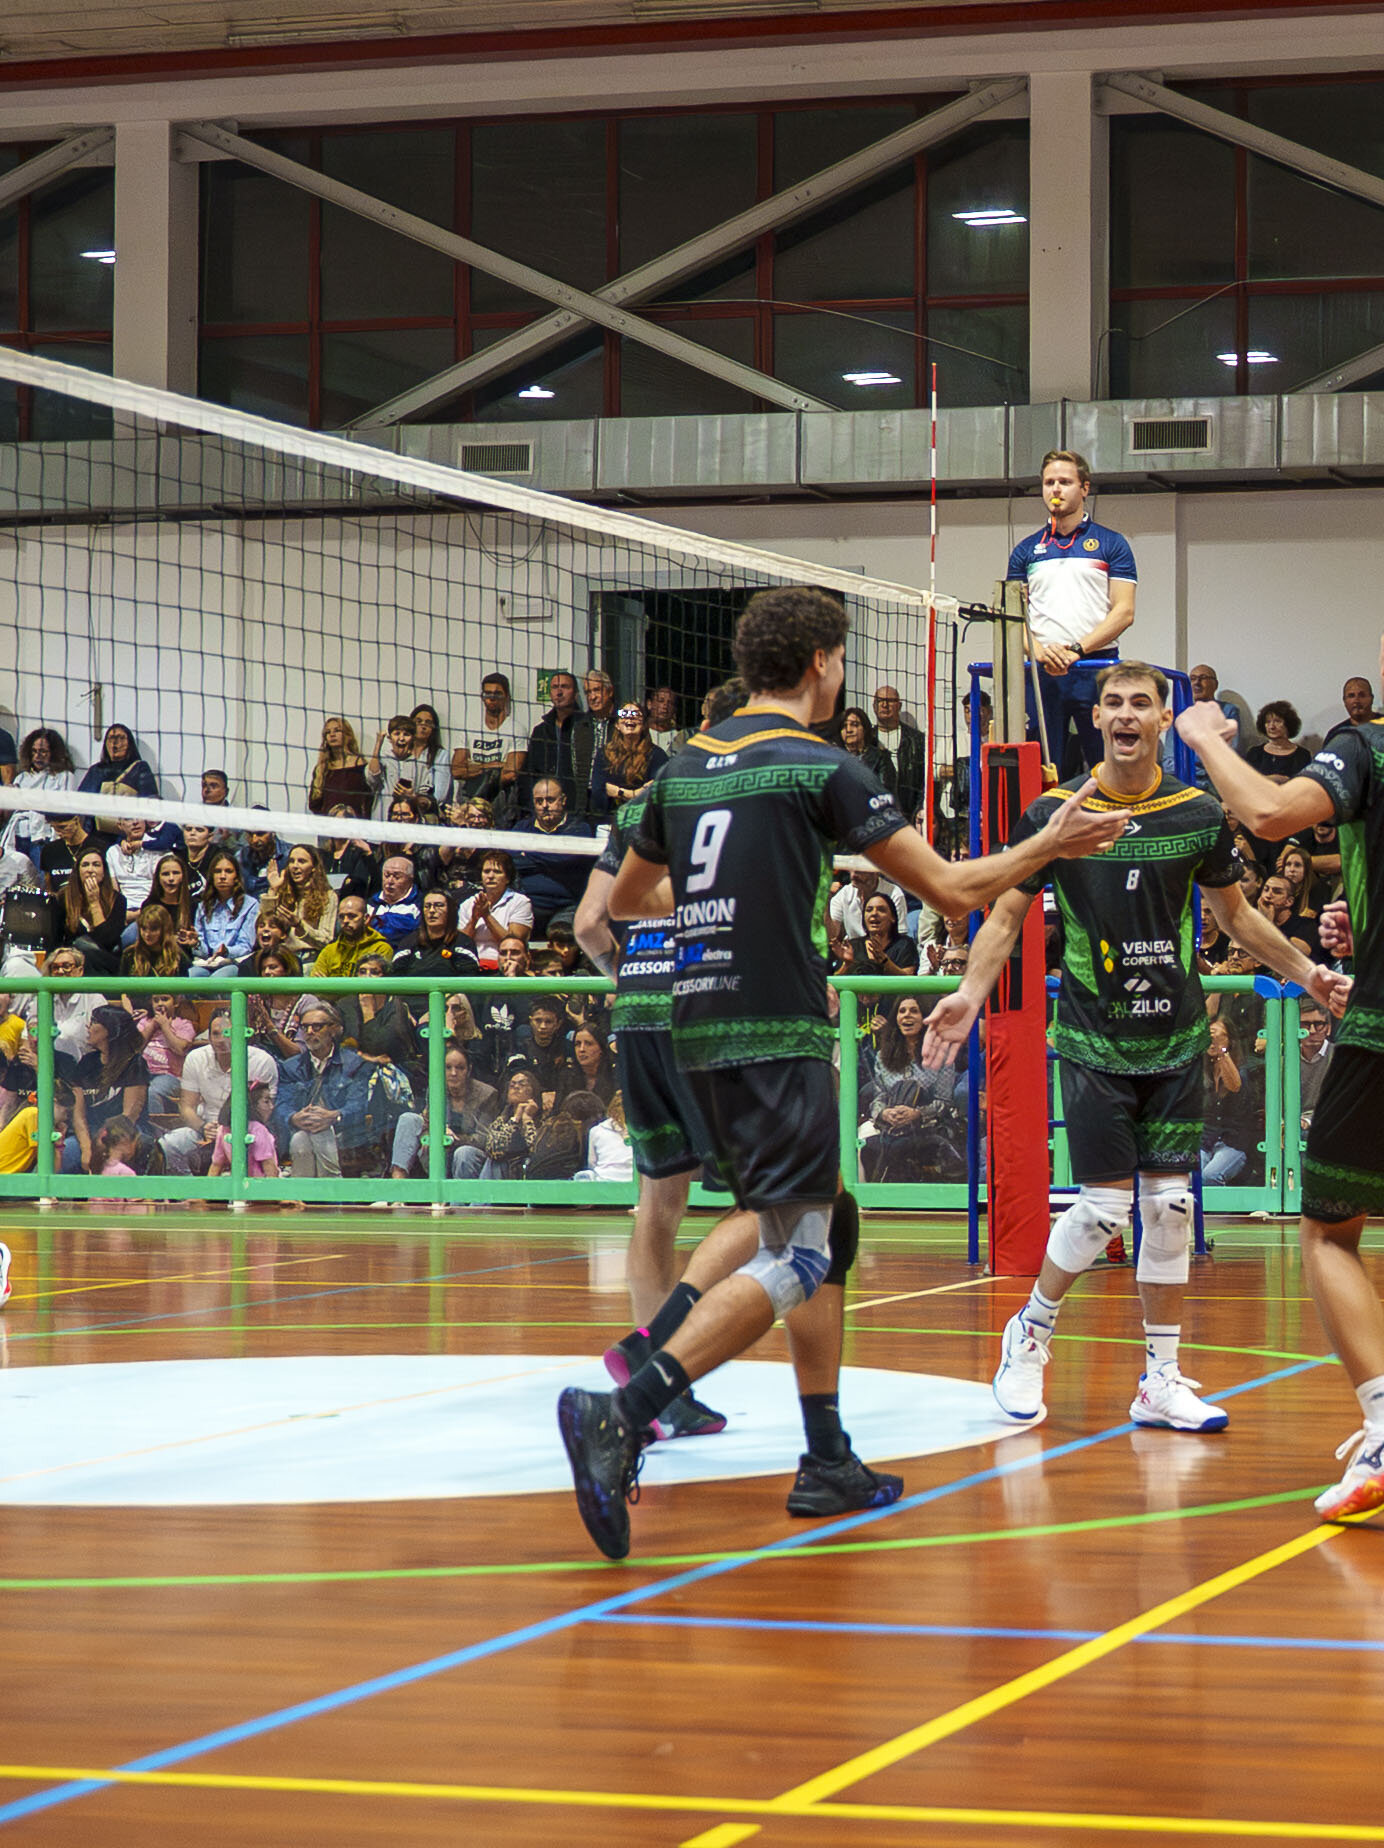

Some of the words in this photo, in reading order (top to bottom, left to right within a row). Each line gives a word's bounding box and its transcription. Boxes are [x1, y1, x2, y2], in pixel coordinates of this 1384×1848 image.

[686, 808, 733, 893] 9
[1126, 869, 1140, 890] 8
[1122, 940, 1175, 955] VENETA
[1131, 997, 1172, 1014] ZILIO
